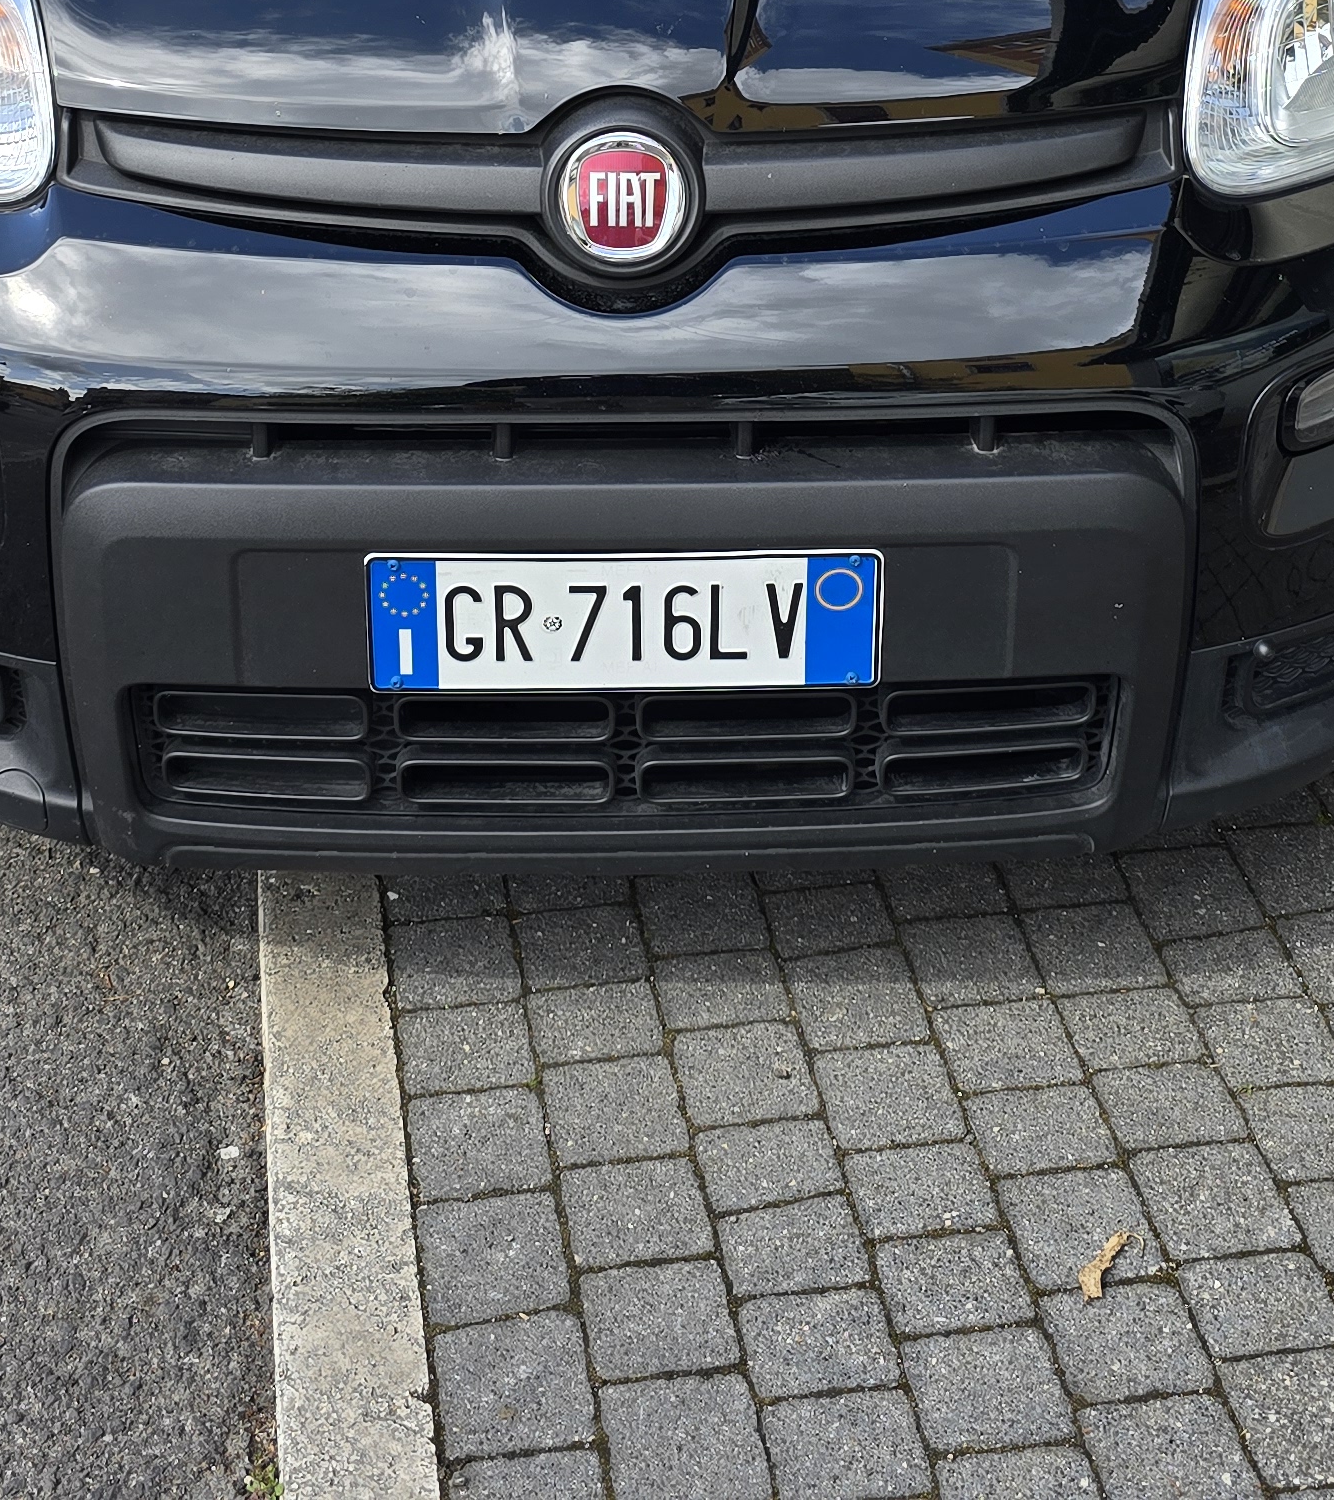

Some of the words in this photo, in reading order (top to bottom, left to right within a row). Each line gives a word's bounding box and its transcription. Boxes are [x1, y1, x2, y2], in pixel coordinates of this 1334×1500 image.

[589, 172, 660, 228] FIAT
[443, 584, 534, 663] GR
[568, 582, 804, 662] 716LV
